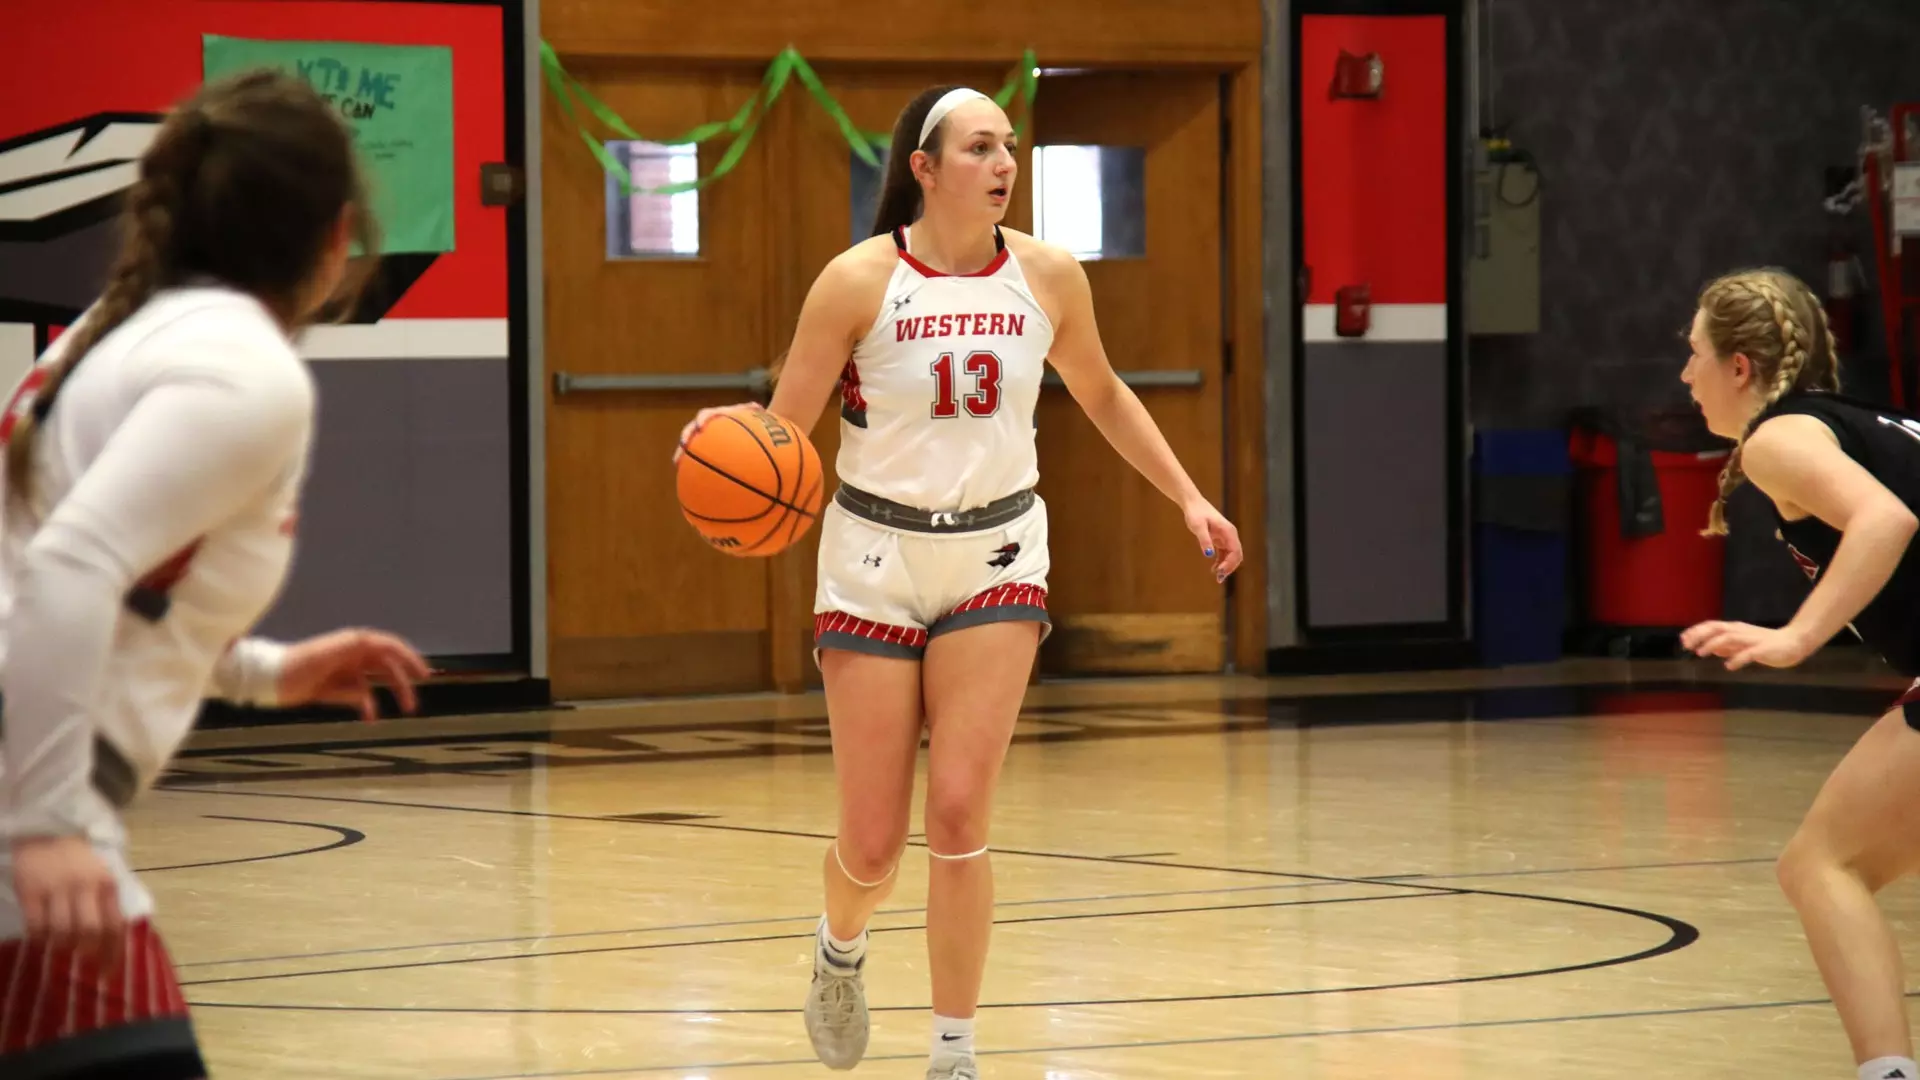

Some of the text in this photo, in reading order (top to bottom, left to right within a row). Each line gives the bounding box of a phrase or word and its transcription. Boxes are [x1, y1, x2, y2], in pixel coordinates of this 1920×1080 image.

[355, 66, 401, 111] ME
[341, 97, 376, 120] CAN
[896, 312, 1026, 343] WESTERN
[929, 350, 1003, 419] 13
